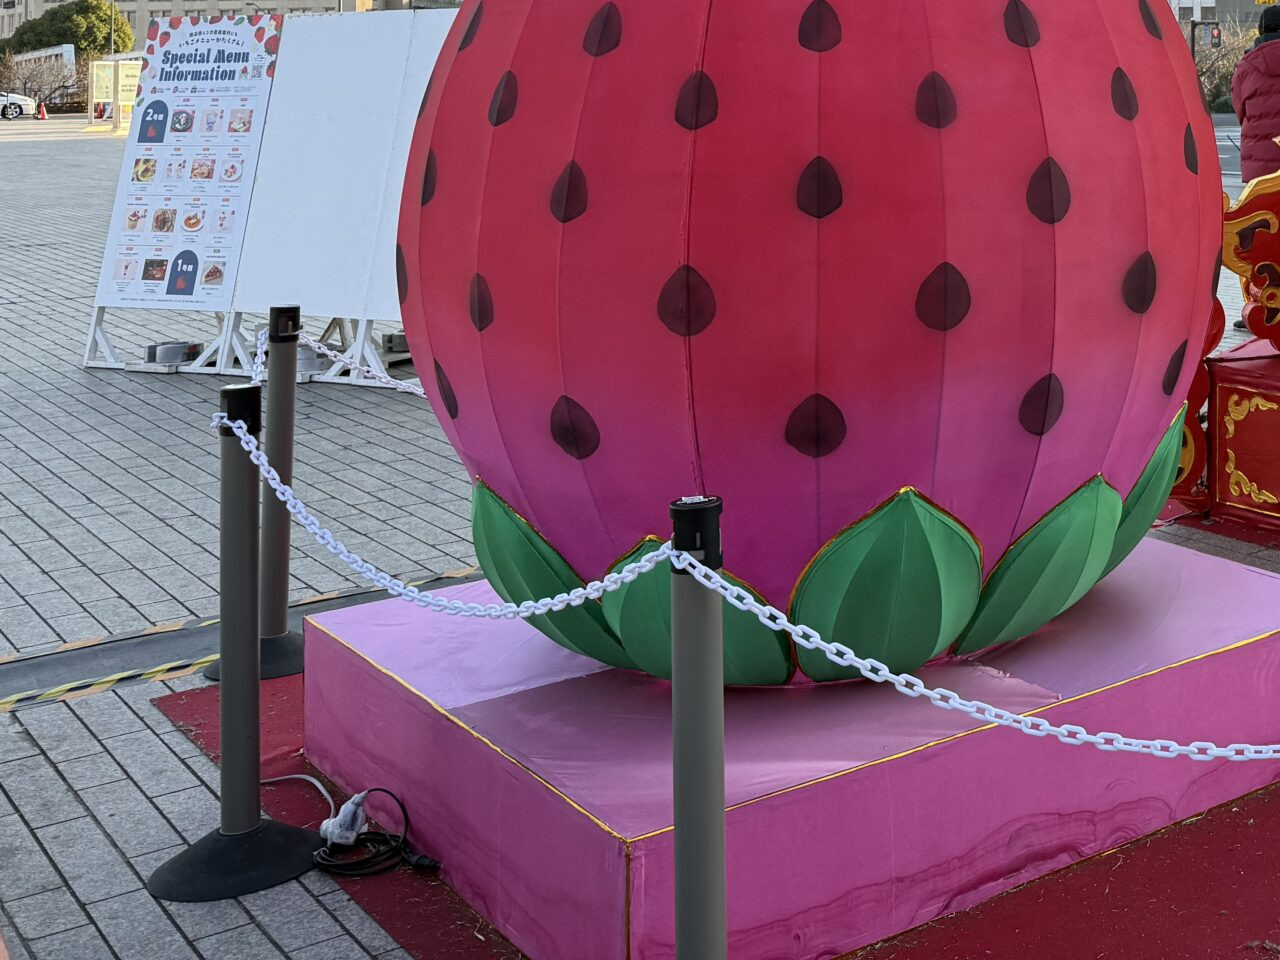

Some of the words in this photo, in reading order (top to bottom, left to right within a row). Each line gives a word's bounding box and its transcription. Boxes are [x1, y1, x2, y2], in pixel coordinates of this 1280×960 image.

[161, 47, 212, 69] Special
[213, 49, 250, 64] Menu
[158, 65, 236, 82] Information
